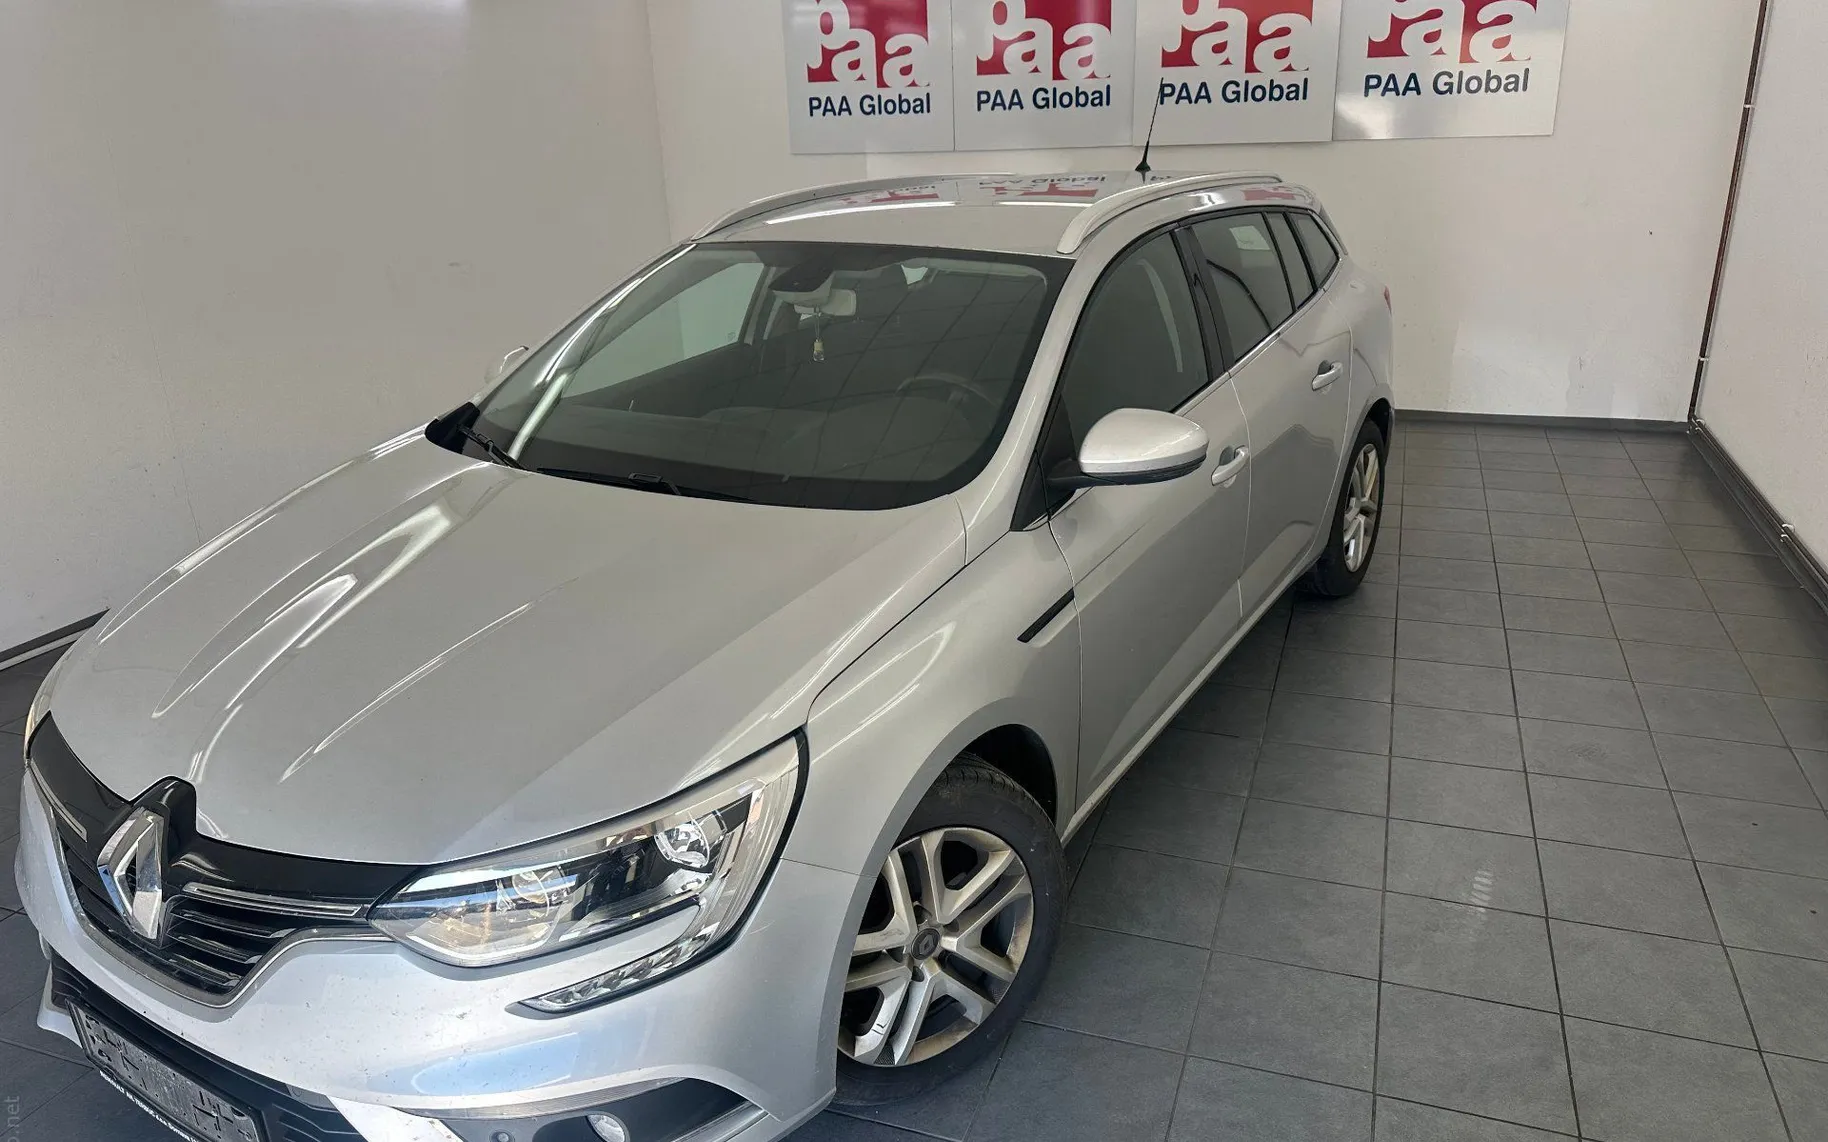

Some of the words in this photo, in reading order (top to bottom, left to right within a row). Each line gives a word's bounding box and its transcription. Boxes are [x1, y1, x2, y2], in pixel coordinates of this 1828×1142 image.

[1159, 80, 1212, 105] PAA
[1221, 77, 1309, 103] Global
[1364, 72, 1421, 97] PAA
[1432, 68, 1530, 95] Global
[808, 95, 852, 117] PAA
[859, 92, 931, 116] Global
[976, 88, 1024, 112] PAA
[1032, 84, 1111, 109] Global
